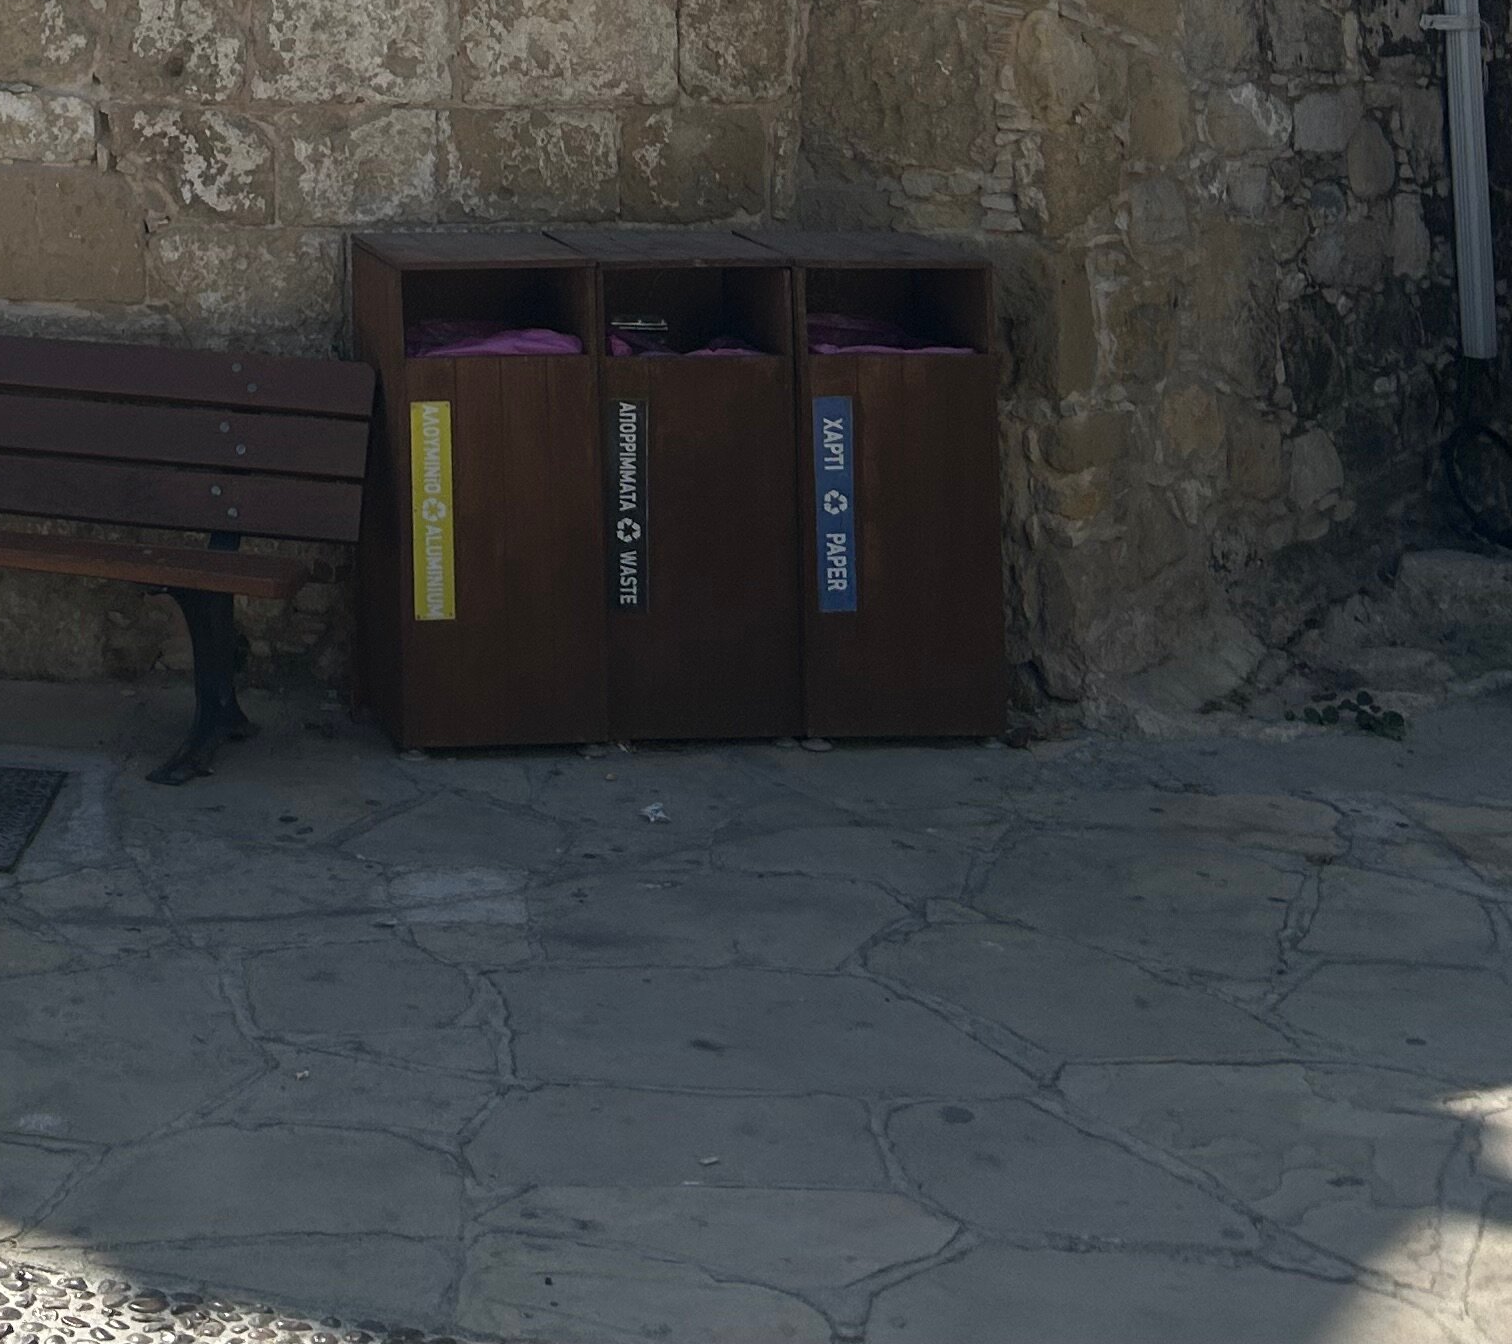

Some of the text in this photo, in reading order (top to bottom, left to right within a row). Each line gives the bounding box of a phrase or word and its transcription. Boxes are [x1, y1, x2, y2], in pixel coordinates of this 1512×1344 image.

[619, 401, 637, 512] ΑΠΟΡΡΙΜΜΑΤΑ
[823, 417, 844, 470] ΧΑΡΤΙ
[425, 524, 445, 620] ALUMINIUM
[619, 550, 637, 605] WASTE
[826, 533, 847, 591] PAPER
